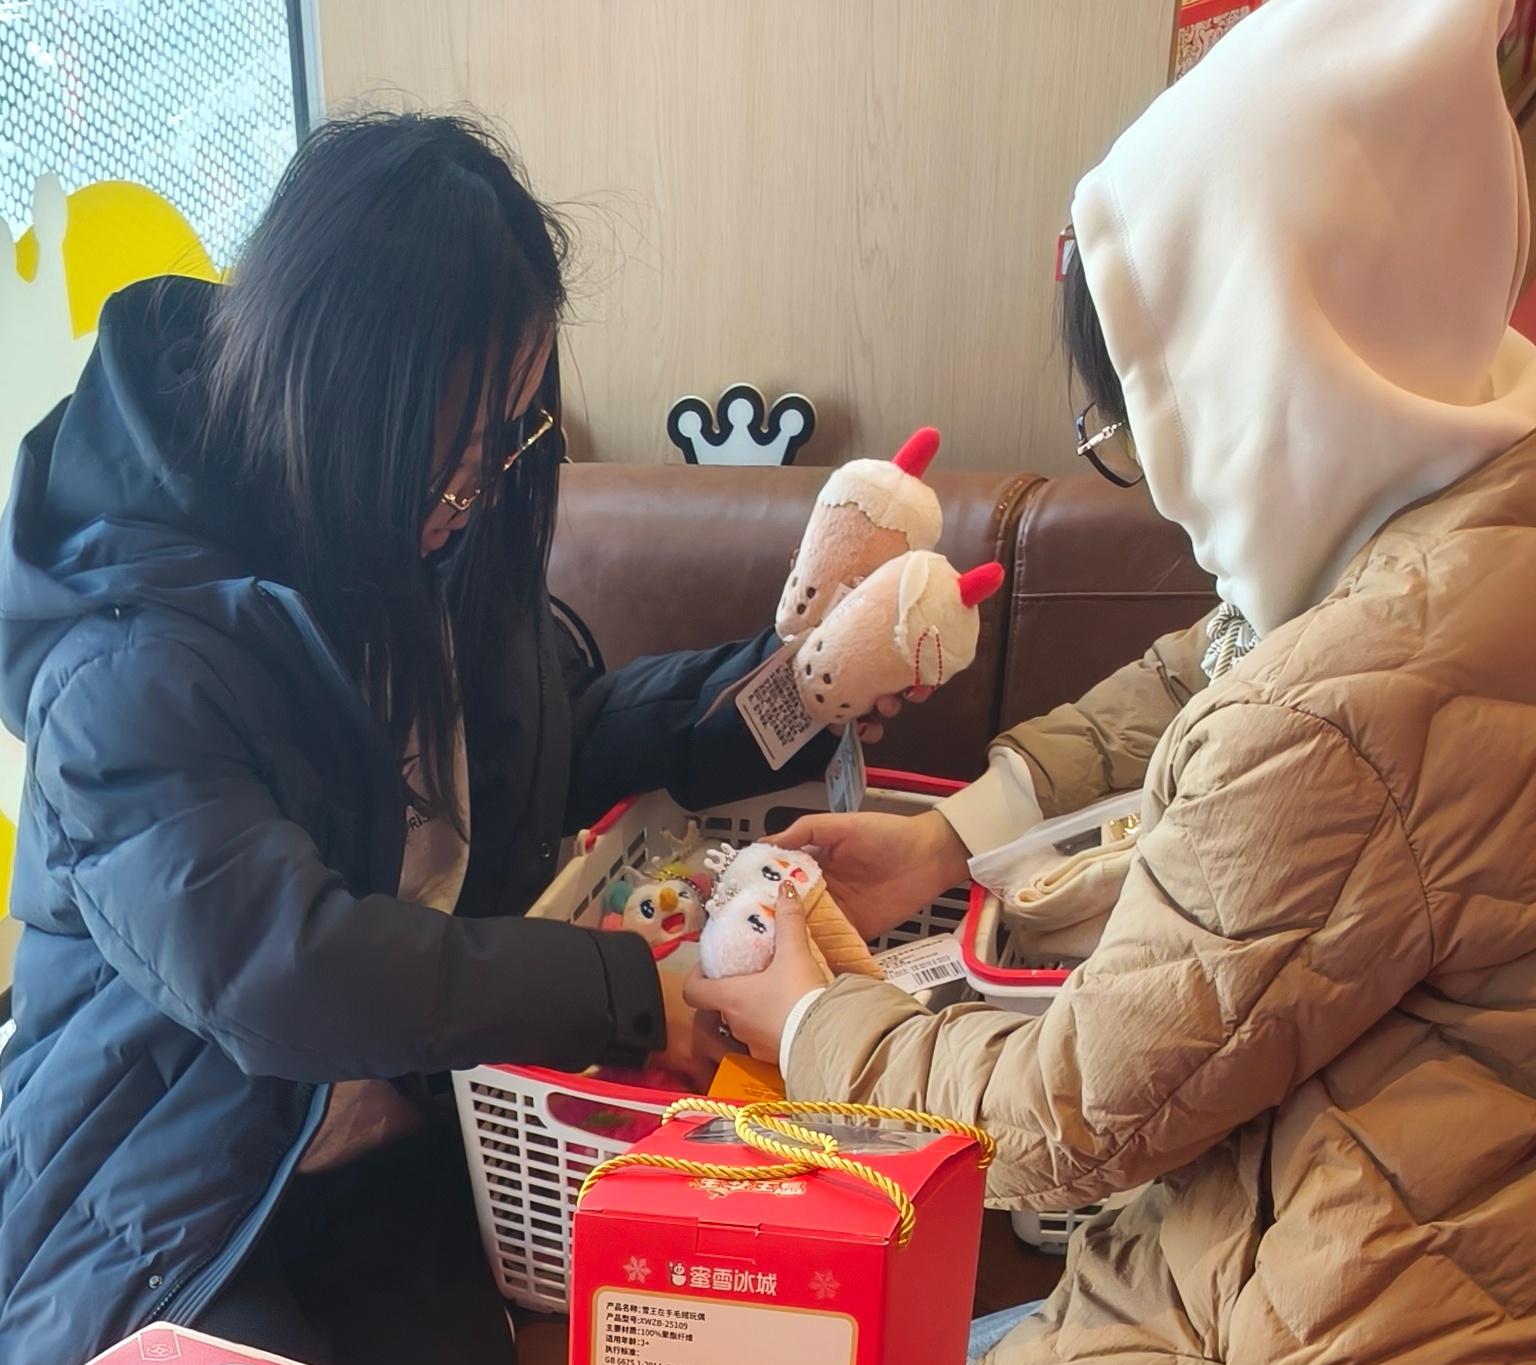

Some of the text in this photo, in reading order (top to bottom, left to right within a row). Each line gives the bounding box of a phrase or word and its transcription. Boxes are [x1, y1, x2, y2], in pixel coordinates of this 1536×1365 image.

[690, 1266, 777, 1296] 蜜雪冰城
[605, 1356, 615, 1364] GB
